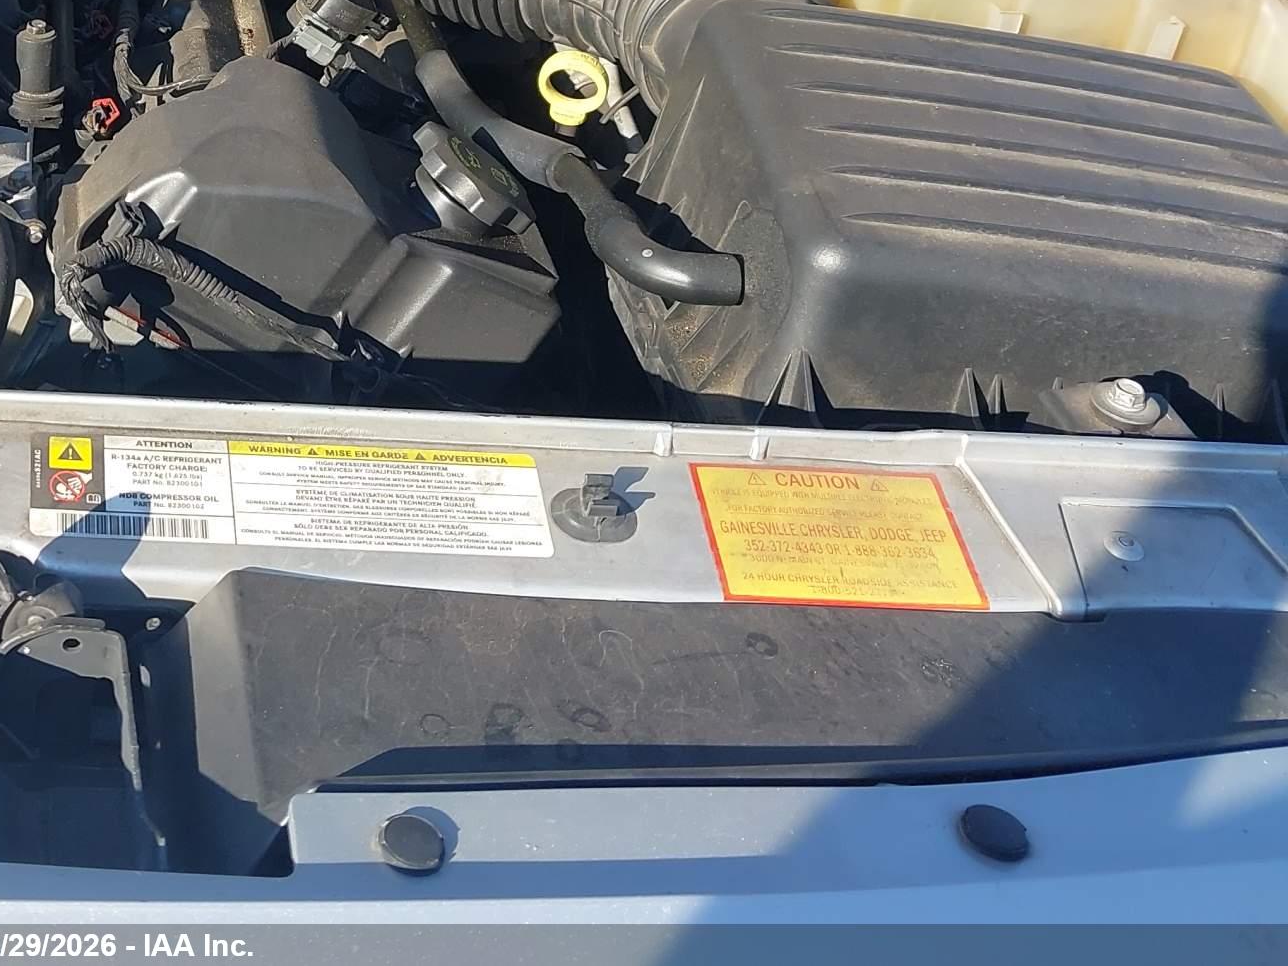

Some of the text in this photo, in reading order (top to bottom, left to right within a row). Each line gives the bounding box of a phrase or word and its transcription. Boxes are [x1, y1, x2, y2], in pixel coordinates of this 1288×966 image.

[135, 439, 192, 449] ATTENTION
[143, 454, 160, 462] A/C
[162, 454, 222, 464] REFRIGERANT
[247, 445, 508, 464] WARNING MISE EN GARDE ADVERTENCIA
[127, 462, 207, 472] FACTORY CHARGE:
[775, 473, 860, 489] CAUTION
[138, 492, 201, 502] COMPRESSOR
[719, 520, 798, 536] GAINESVILLE
[919, 529, 947, 543] JEEP
[743, 539, 824, 555] 352-372-4343
[825, 542, 842, 555] OR
[743, 572, 754, 581] 24
[757, 573, 786, 581] HOUR
[788, 574, 840, 584] CHRYSLER
